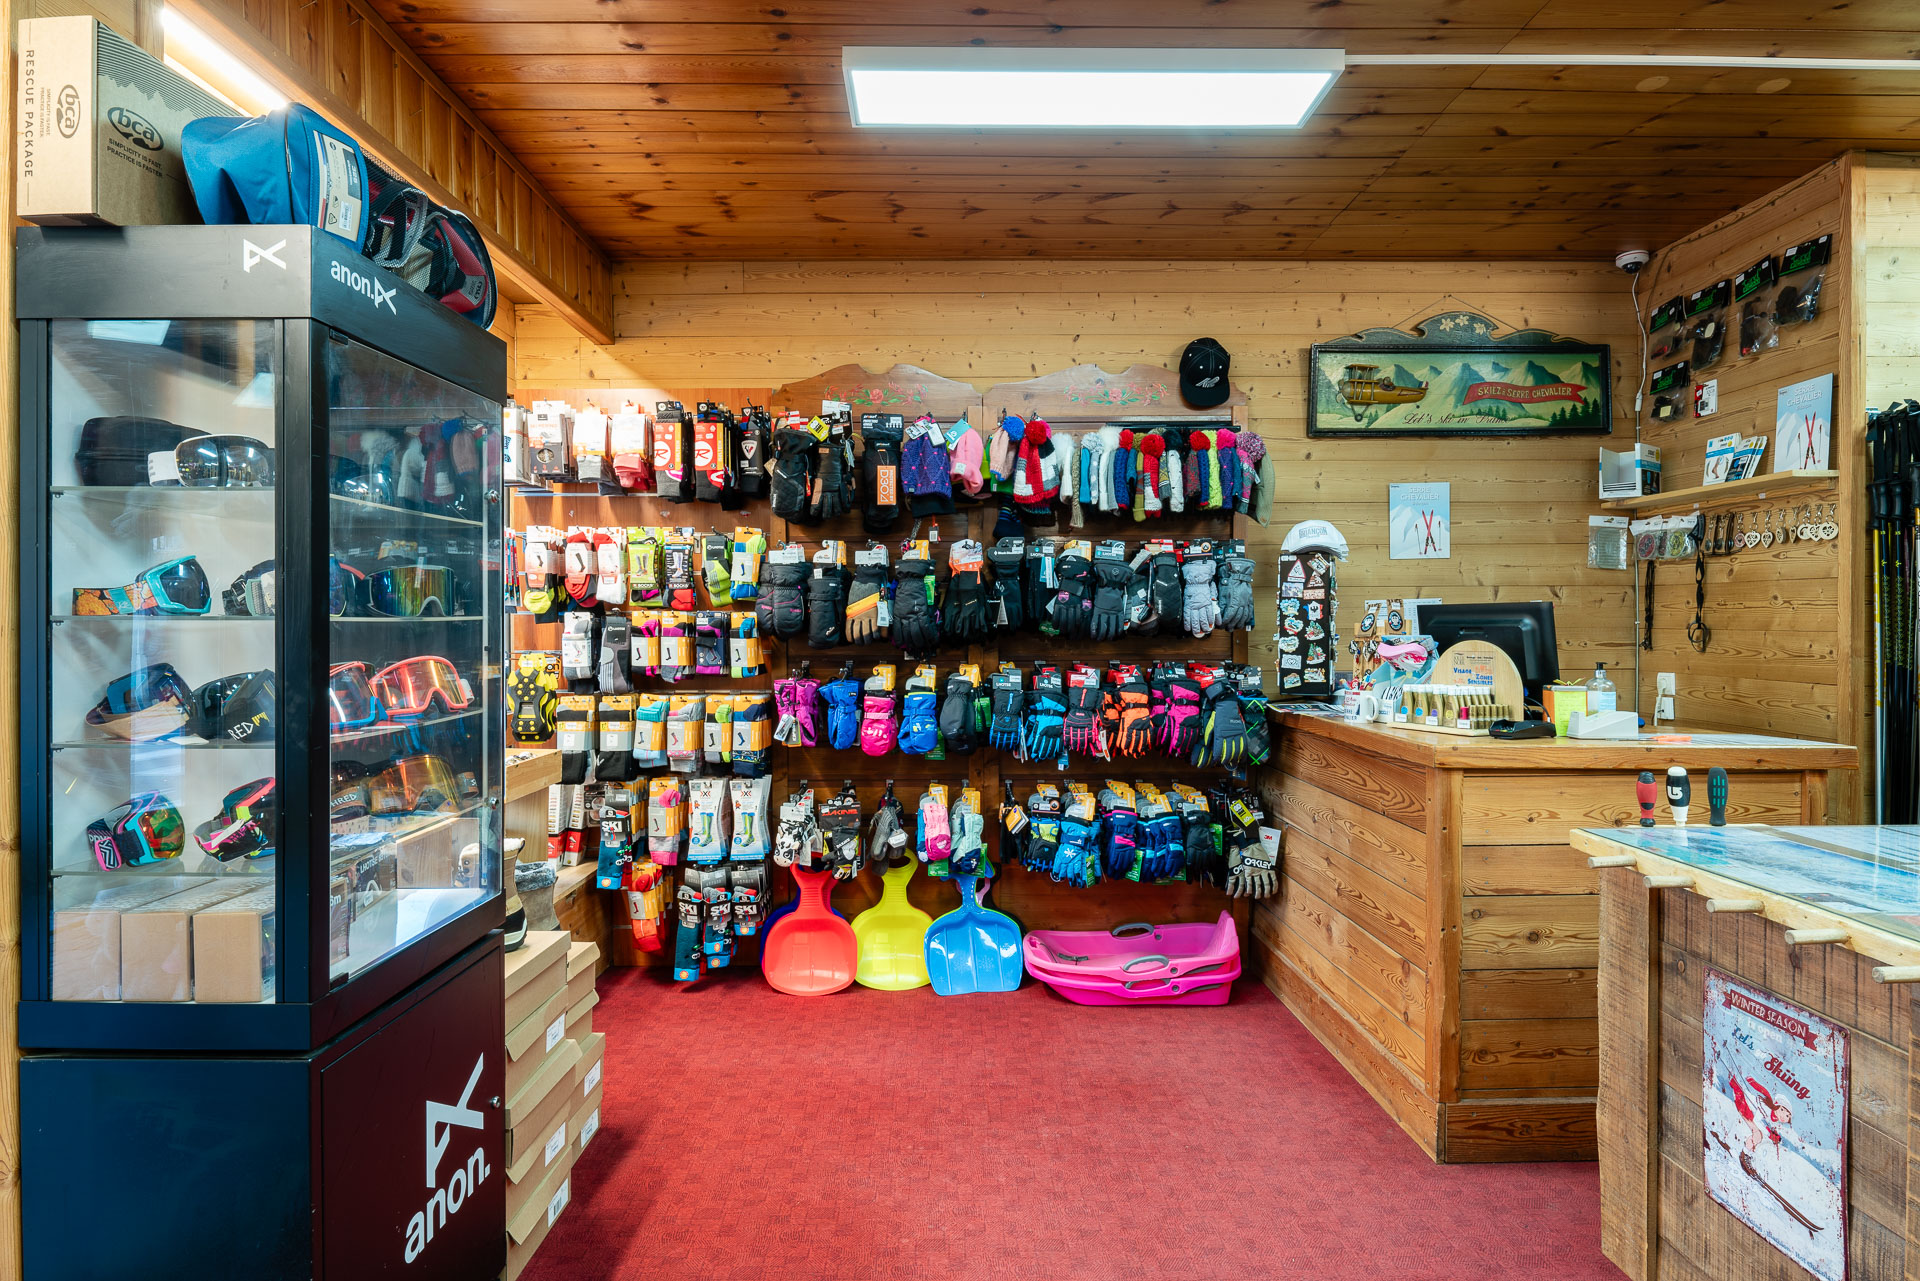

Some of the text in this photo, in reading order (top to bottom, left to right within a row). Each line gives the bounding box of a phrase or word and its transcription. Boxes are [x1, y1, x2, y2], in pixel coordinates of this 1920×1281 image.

[24, 49, 34, 177] RESCUE PACKAGE
[108, 138, 141, 158] SIMPLICITY
[107, 146, 135, 165] PRACTICE
[1477, 386, 1501, 396] SKIEZ
[1507, 388, 1530, 399] SERRE
[1532, 387, 1572, 398] CHEVALIER
[1794, 384, 1815, 396] SERRE
[1787, 391, 1823, 407] CHEVALIER
[1402, 412, 1511, 425] Let's ski in France
[1400, 493, 1440, 501] CHEVALIER
[331, 794, 357, 807] HRED
[601, 821, 622, 832] SKI
[1244, 857, 1272, 870] OAKLEY
[678, 902, 698, 915] SKI
[710, 902, 731, 916] SKI
[735, 904, 757, 915] SKI
[1731, 992, 1807, 1038] WINTER SEASON
[1731, 1024, 1755, 1051] Let's
[1757, 1025, 1783, 1043] open
[1763, 1052, 1811, 1100] Skiing
[404, 1147, 491, 1264] anon.
